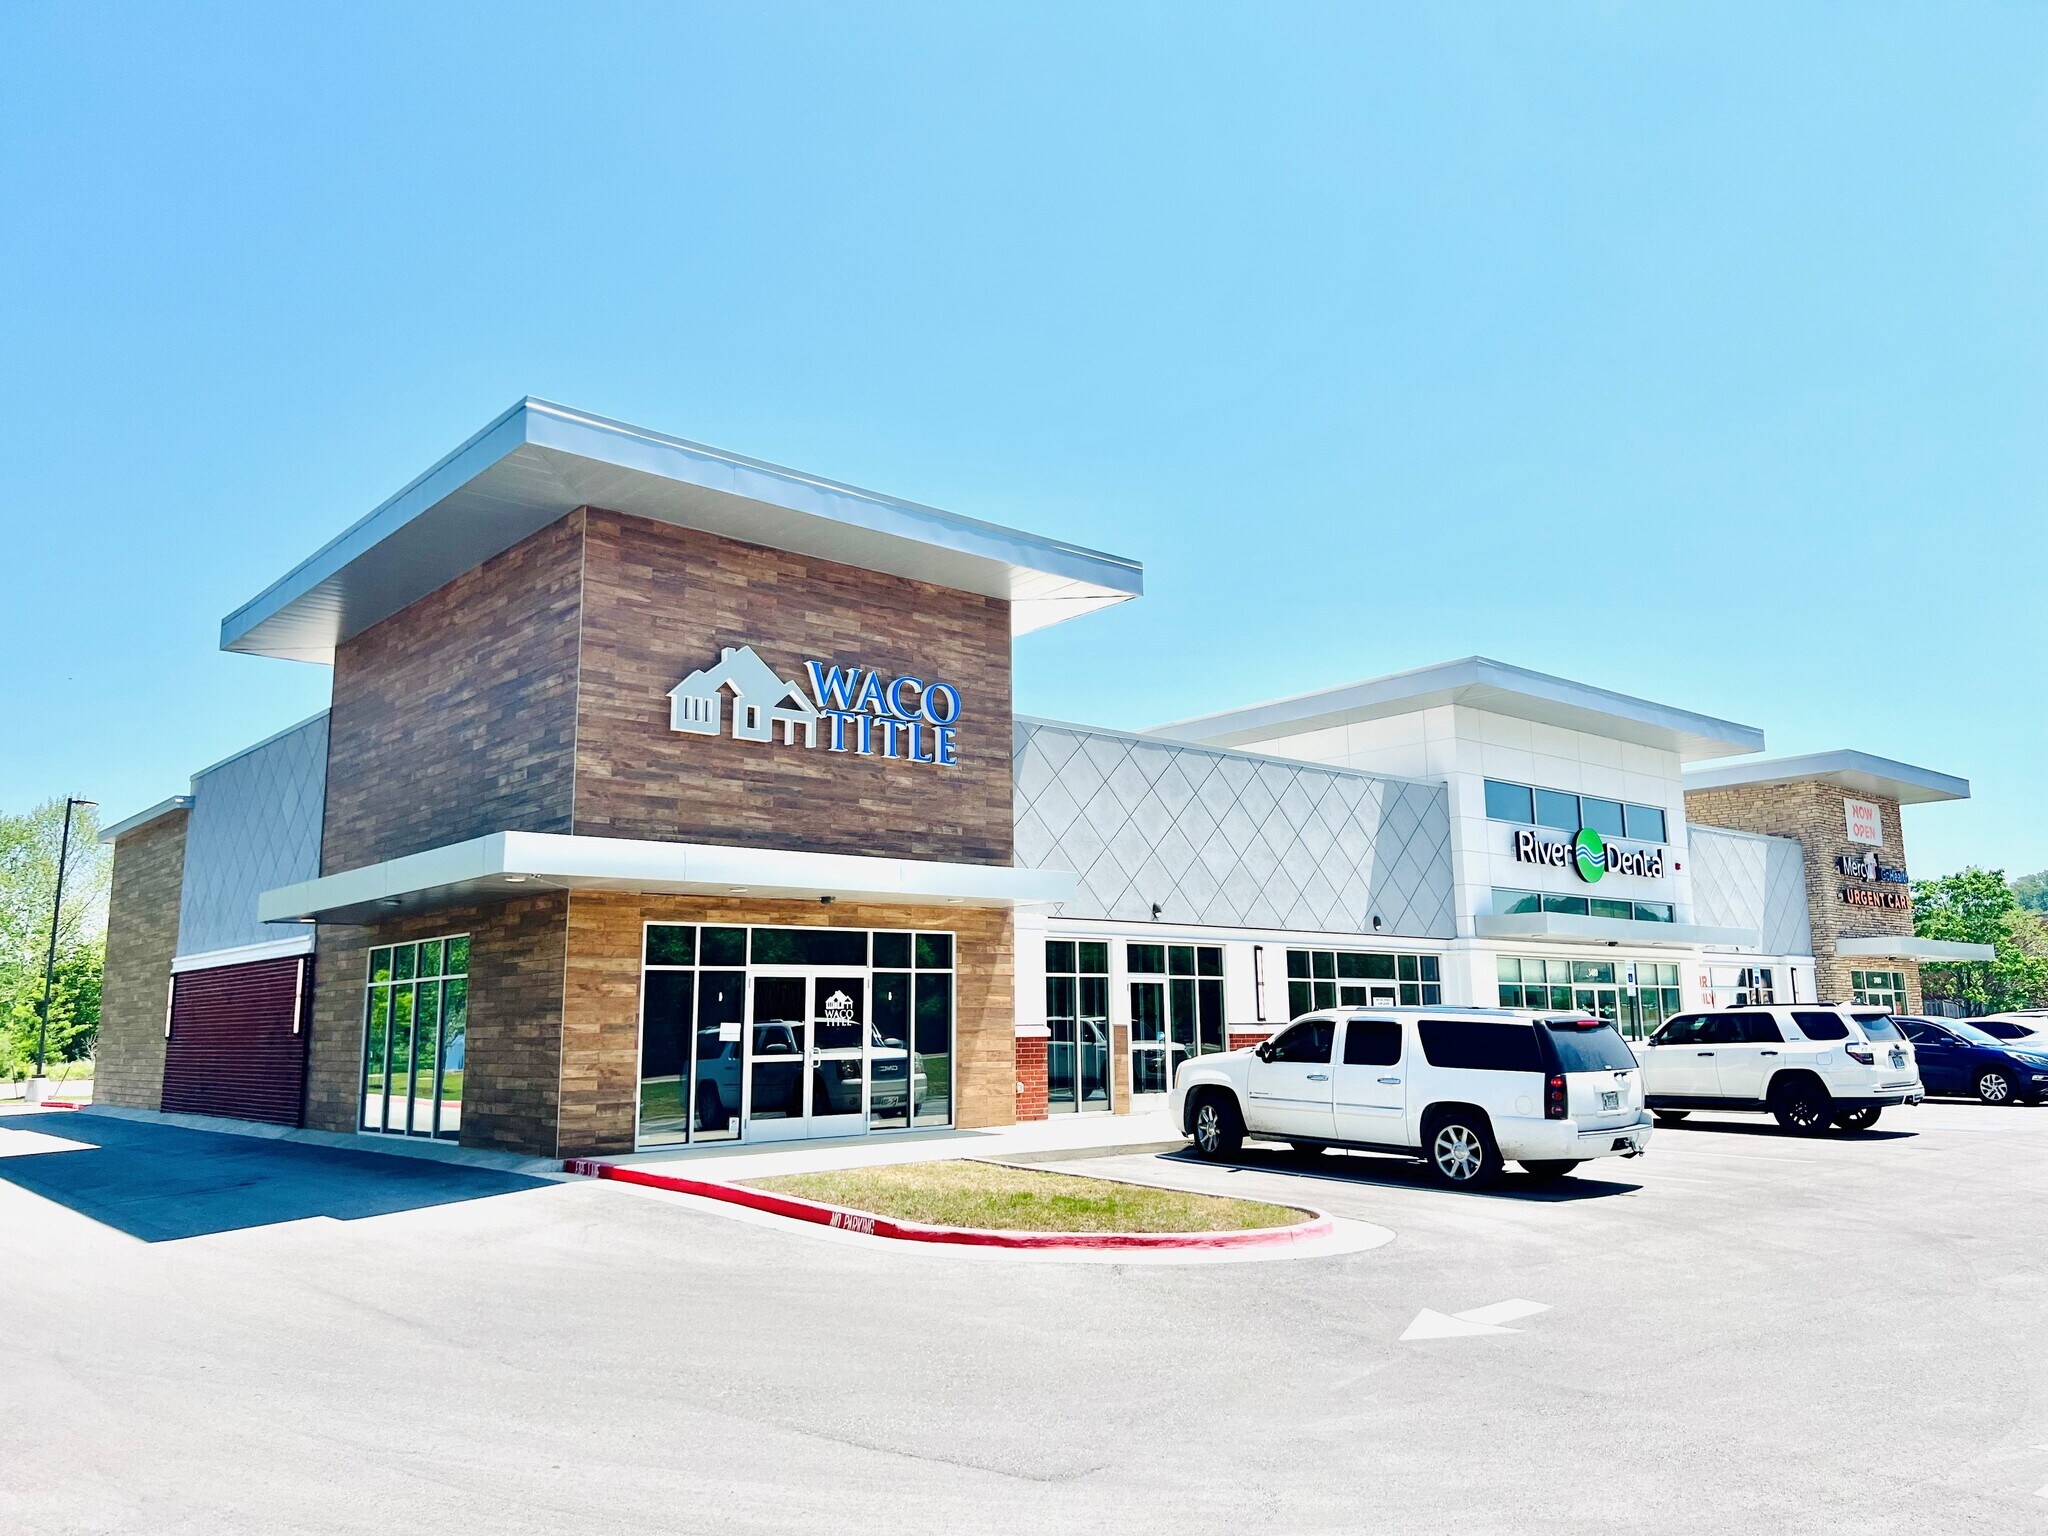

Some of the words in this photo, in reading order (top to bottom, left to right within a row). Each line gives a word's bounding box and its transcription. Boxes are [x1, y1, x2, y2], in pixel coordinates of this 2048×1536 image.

[804, 660, 961, 725] WACO
[820, 709, 958, 766] TITLE
[1852, 805, 1873, 820] NOW
[1853, 823, 1876, 840] OPEN
[1516, 830, 1573, 867] River
[1604, 842, 1666, 878] Dental
[1842, 855, 1870, 882] Mercy
[1846, 888, 1886, 907] URGENT
[825, 1009, 854, 1019] WACO
[830, 1211, 842, 1228] NO
[843, 1214, 875, 1235] PARKING
